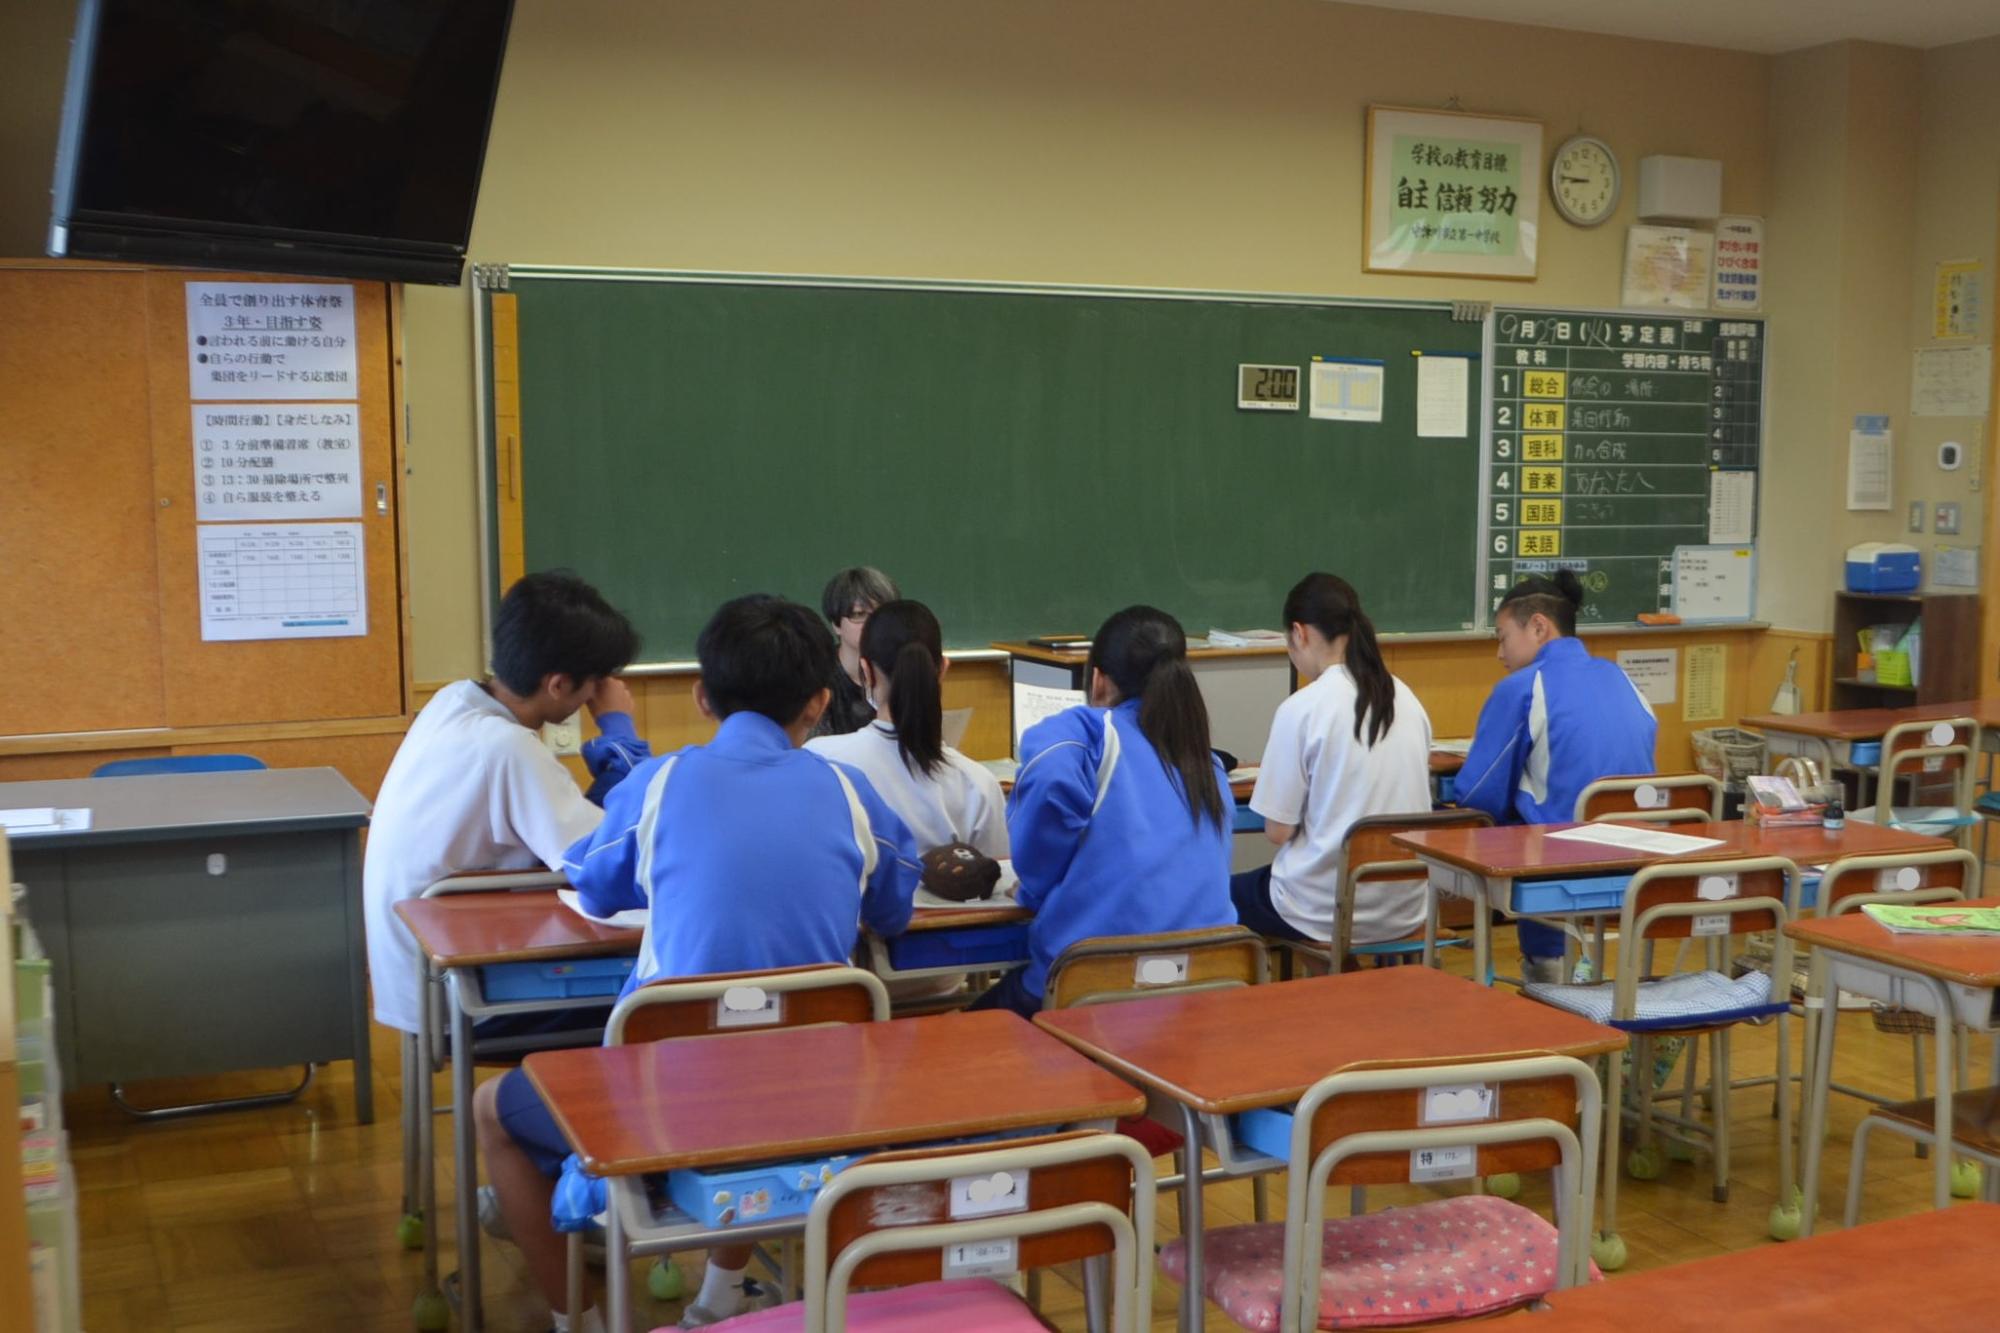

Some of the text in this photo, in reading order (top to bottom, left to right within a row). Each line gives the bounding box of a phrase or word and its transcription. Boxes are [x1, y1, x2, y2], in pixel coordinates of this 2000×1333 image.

[1411, 143, 1508, 172] 学校の教育目標
[1398, 175, 1517, 216] 自主 信頼 努力
[201, 293, 342, 308] 全員で創り出す体育祭
[1619, 324, 1675, 344] 予定表
[211, 370, 348, 382] 集団をリードする応援団
[1715, 366, 1722, 376] 1
[1501, 374, 1510, 393] 1
[1529, 377, 1559, 394] 総合
[1714, 386, 1723, 398] 2
[1497, 406, 1511, 425] 2
[1529, 408, 1558, 426] 体育
[1713, 407, 1721, 418] 3
[1713, 428, 1721, 439] 4
[1497, 439, 1511, 457] 3
[1527, 440, 1557, 458] 理科
[1712, 449, 1721, 461] 5
[1496, 471, 1510, 489] 4
[1527, 472, 1557, 489] 音楽
[1495, 503, 1509, 521] 5
[1526, 504, 1555, 522] 国語
[1493, 535, 1508, 553] 6
[1524, 536, 1553, 553] 英語
[957, 1247, 965, 1261] 1
